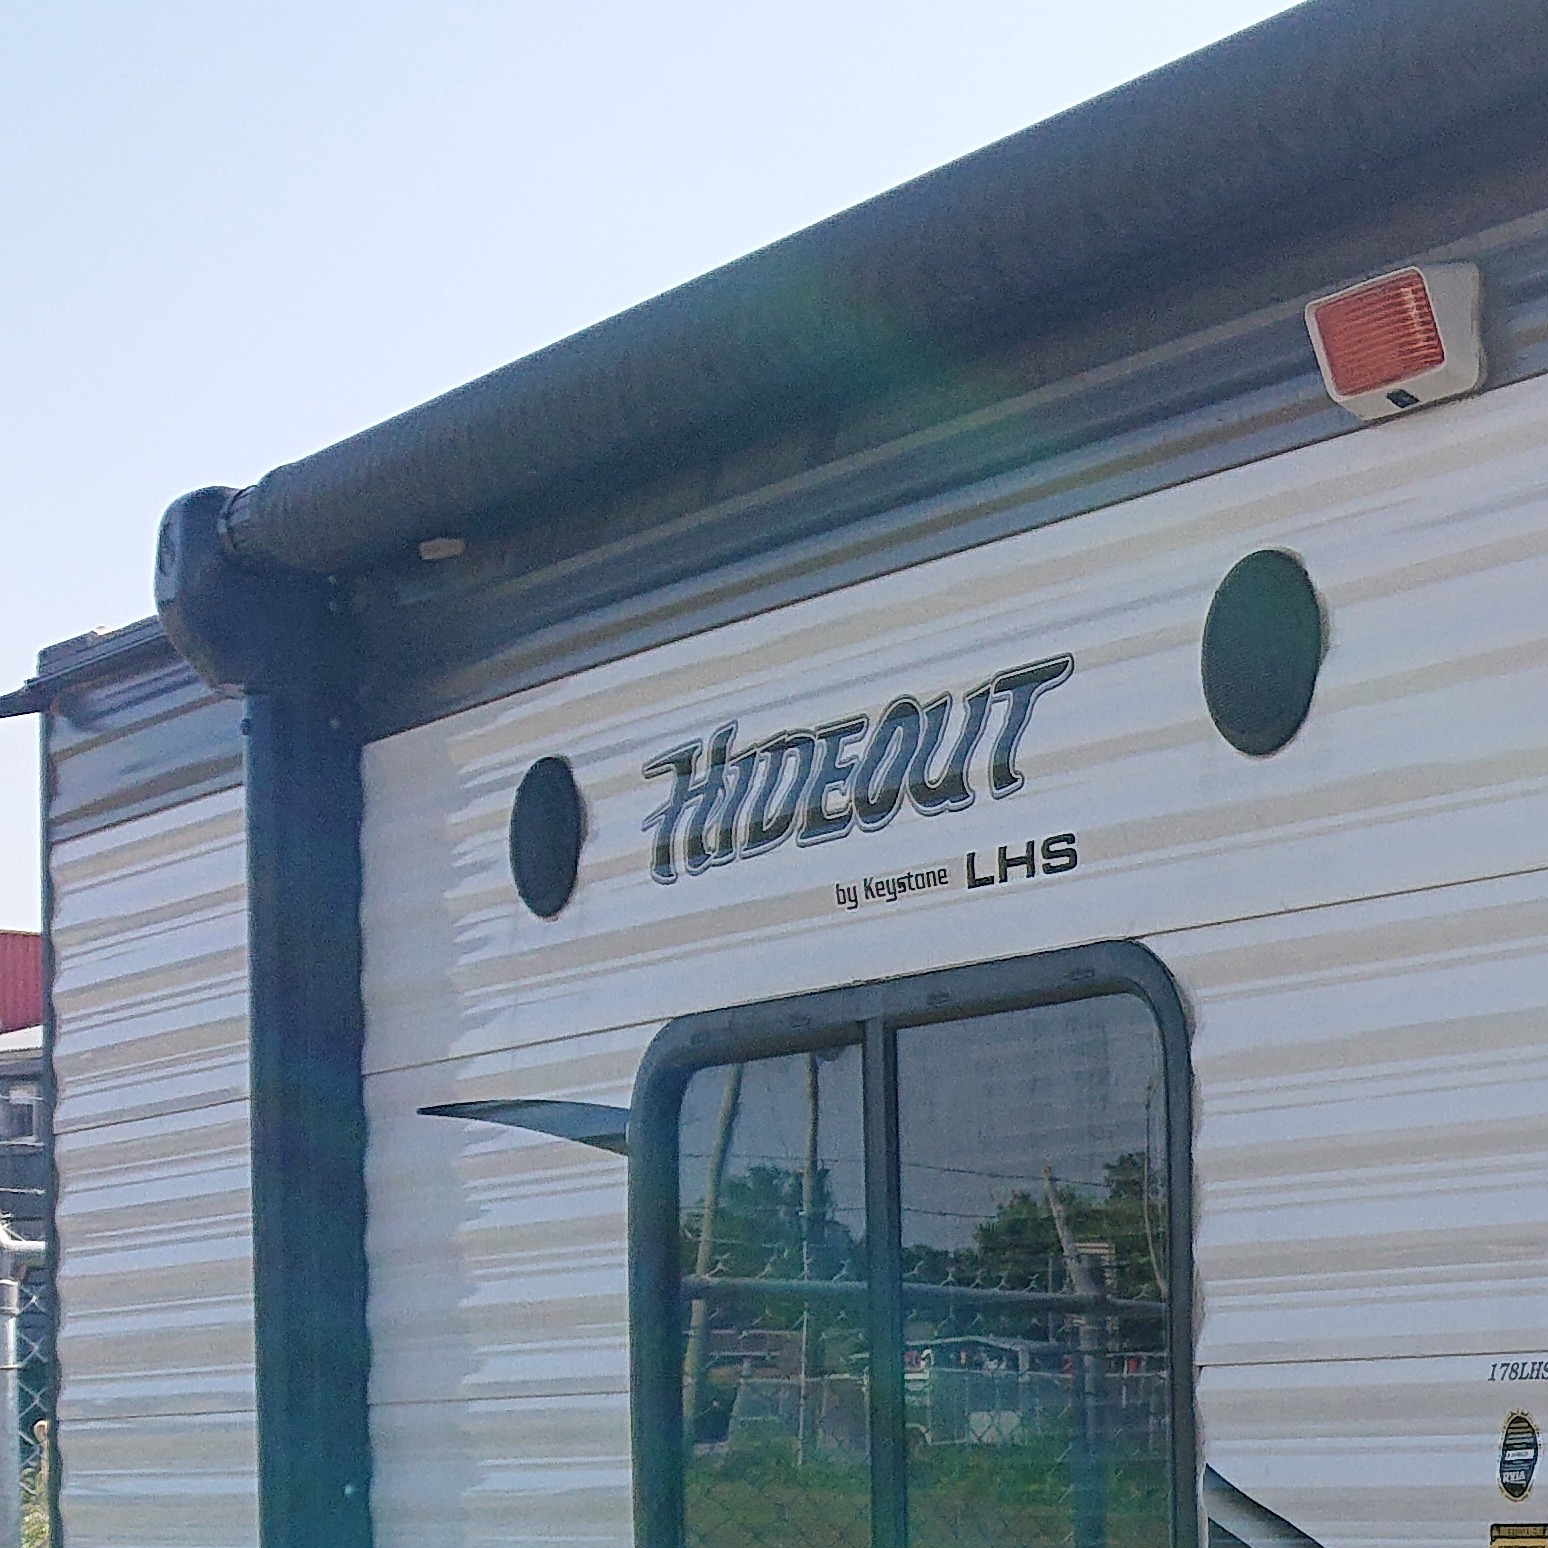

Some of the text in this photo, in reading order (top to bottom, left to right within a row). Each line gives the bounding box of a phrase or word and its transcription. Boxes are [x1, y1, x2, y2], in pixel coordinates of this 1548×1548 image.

[641, 652, 1075, 885] HIDEOUT
[836, 832, 1079, 910] by Keystone LHS
